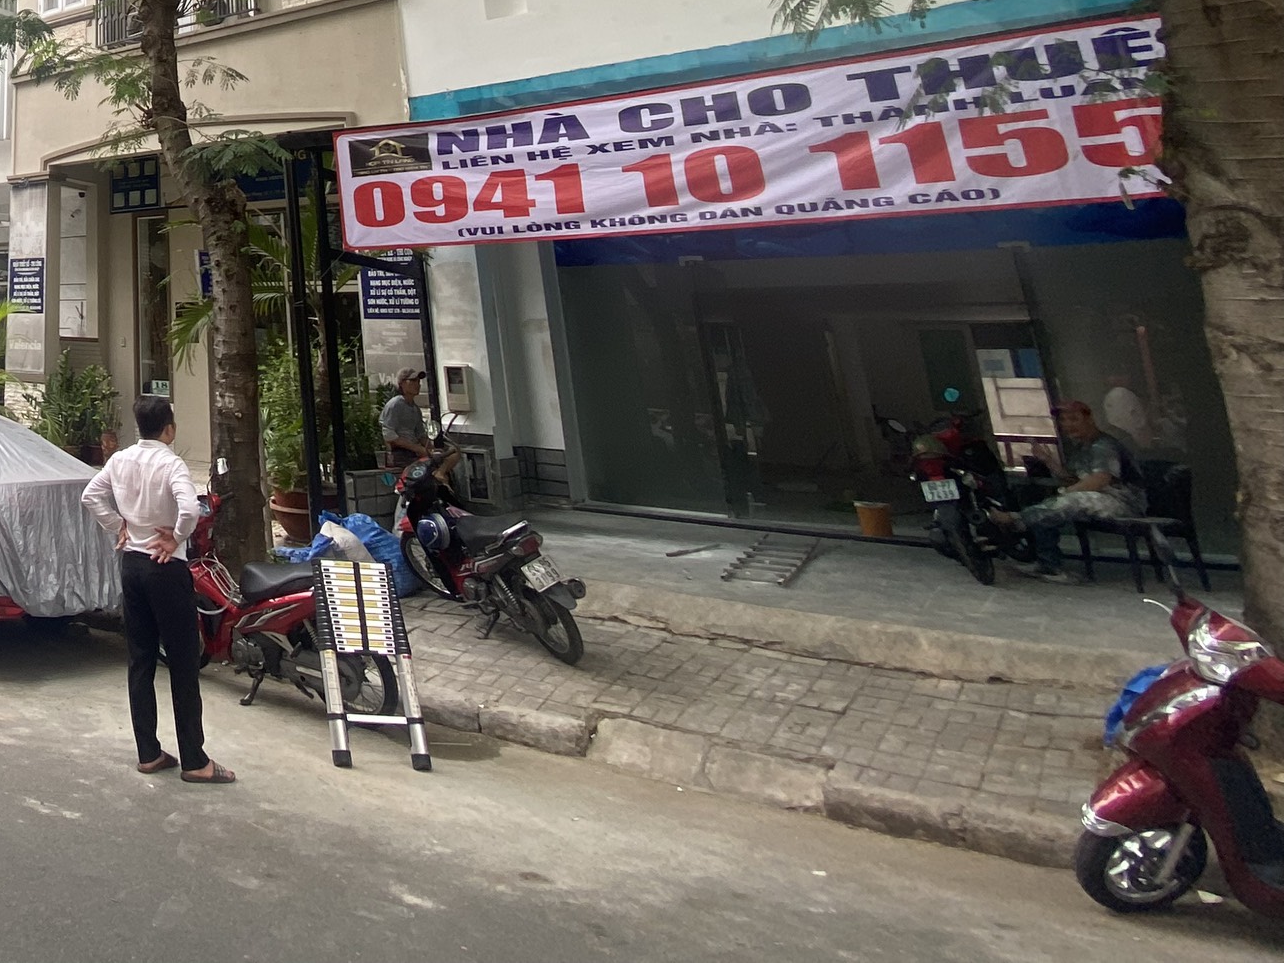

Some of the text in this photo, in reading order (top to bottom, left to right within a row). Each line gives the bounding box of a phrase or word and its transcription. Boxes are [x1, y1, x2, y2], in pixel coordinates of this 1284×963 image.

[436, 27, 1160, 156] NHÀ CHO THUÊ
[353, 97, 1163, 228] 0941 10 1155
[442, 154, 515, 170] LIÊN
[527, 145, 574, 161] HỆ
[587, 135, 675, 155] XEM
[691, 121, 798, 144] NHÀ:
[457, 187, 1001, 238] (VUI LÒNG KHÔNG DÁN QUẢNG CÁO)
